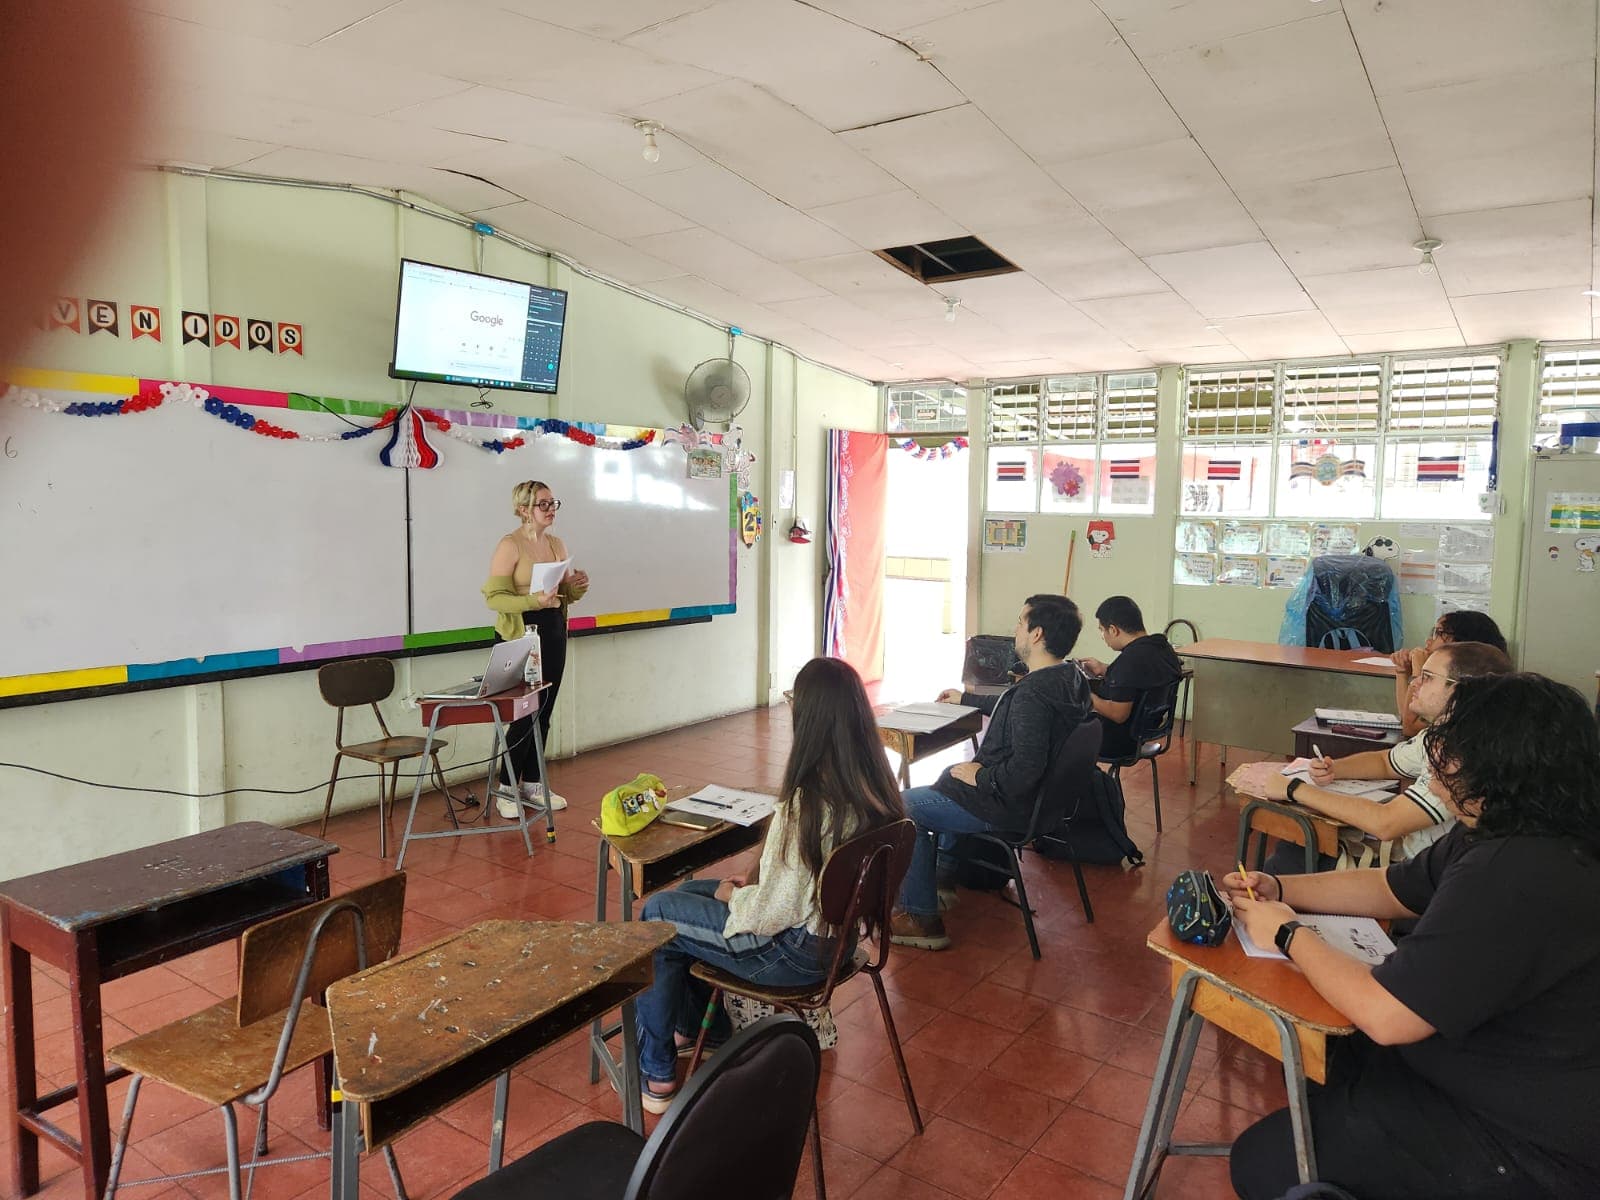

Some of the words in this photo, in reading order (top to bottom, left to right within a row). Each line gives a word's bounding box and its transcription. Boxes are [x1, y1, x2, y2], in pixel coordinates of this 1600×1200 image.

[470, 310, 504, 327] Google
[4, 436, 18, 459] 6
[744, 511, 756, 532] 2
